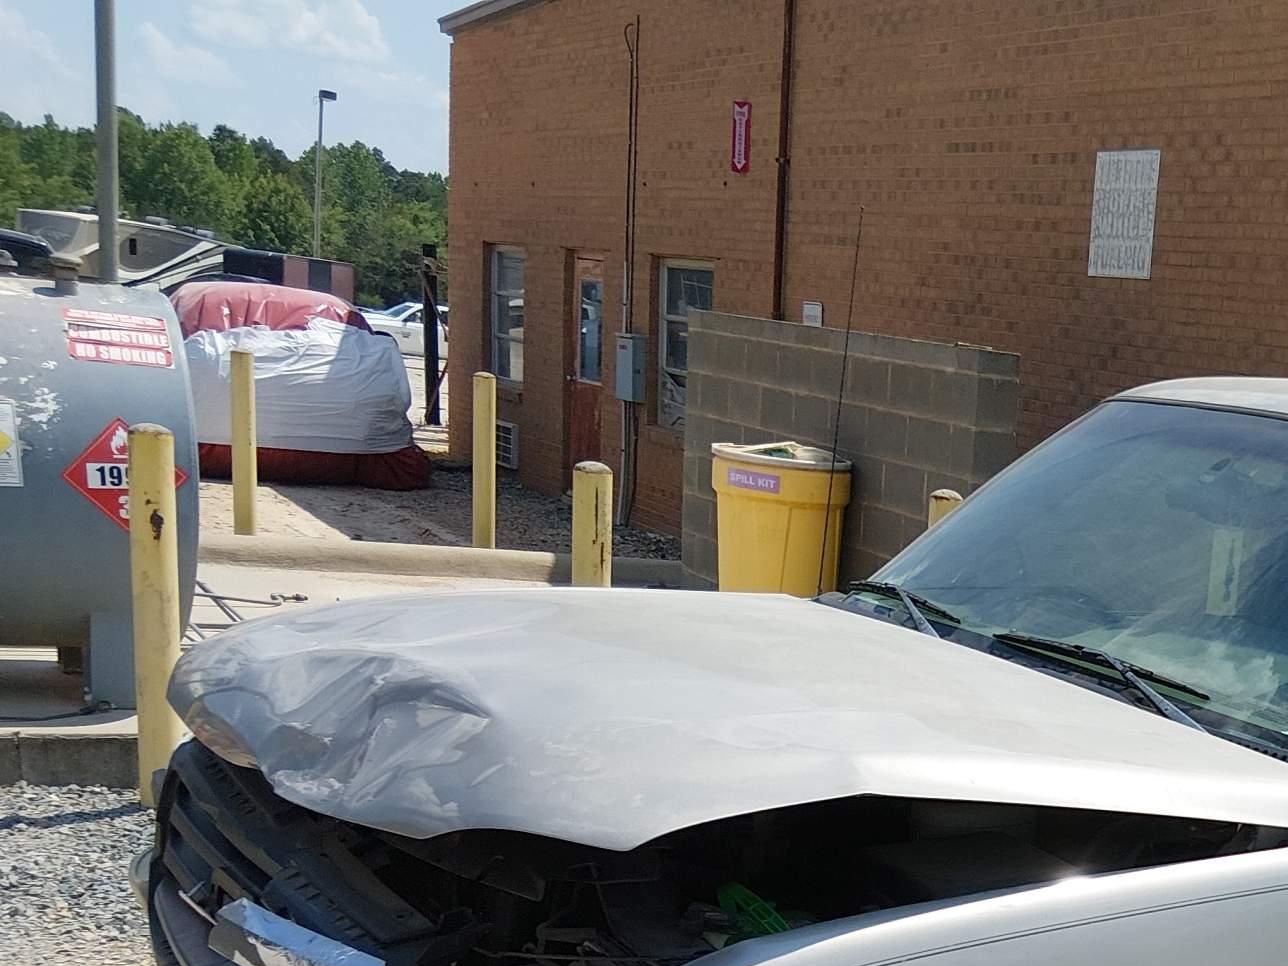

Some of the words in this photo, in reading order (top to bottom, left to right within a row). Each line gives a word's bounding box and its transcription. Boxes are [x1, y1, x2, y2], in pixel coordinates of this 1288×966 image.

[75, 342, 97, 358] NO
[99, 345, 167, 365] SMOKING
[95, 465, 129, 487] 19
[729, 472, 756, 486] SPILL
[758, 477, 777, 489] KIT
